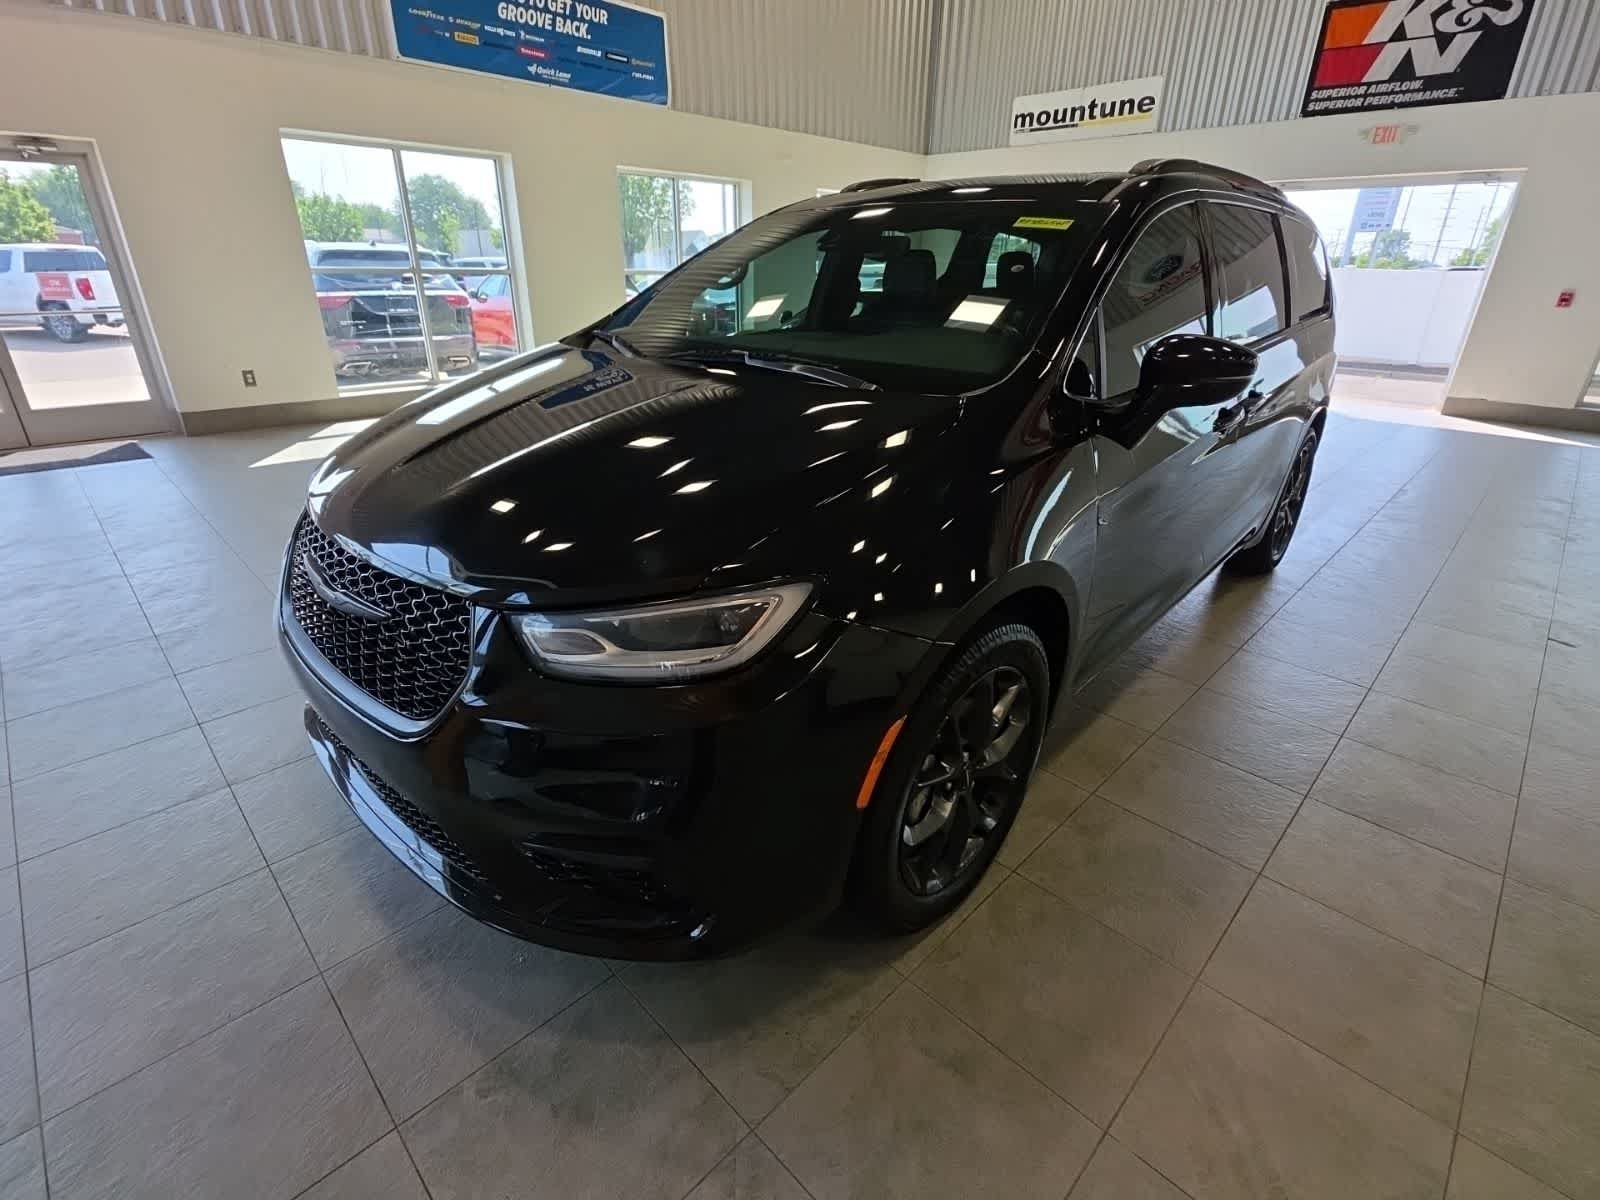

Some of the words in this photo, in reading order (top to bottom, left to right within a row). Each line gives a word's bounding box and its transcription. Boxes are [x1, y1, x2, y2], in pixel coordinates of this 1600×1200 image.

[497, 2, 553, 31] GROOVE
[555, 15, 592, 40] BACK.
[547, 0, 573, 16] GET
[575, 2, 608, 25] YOUR
[537, 65, 555, 76] Quick
[556, 69, 572, 79] Lane
[1309, 85, 1367, 99] SUPERIOR
[1368, 79, 1425, 94] AIRFLOW.
[1013, 95, 1156, 129] mountune
[1307, 96, 1365, 111] SUPERIOR
[1372, 125, 1400, 145] EXIT
